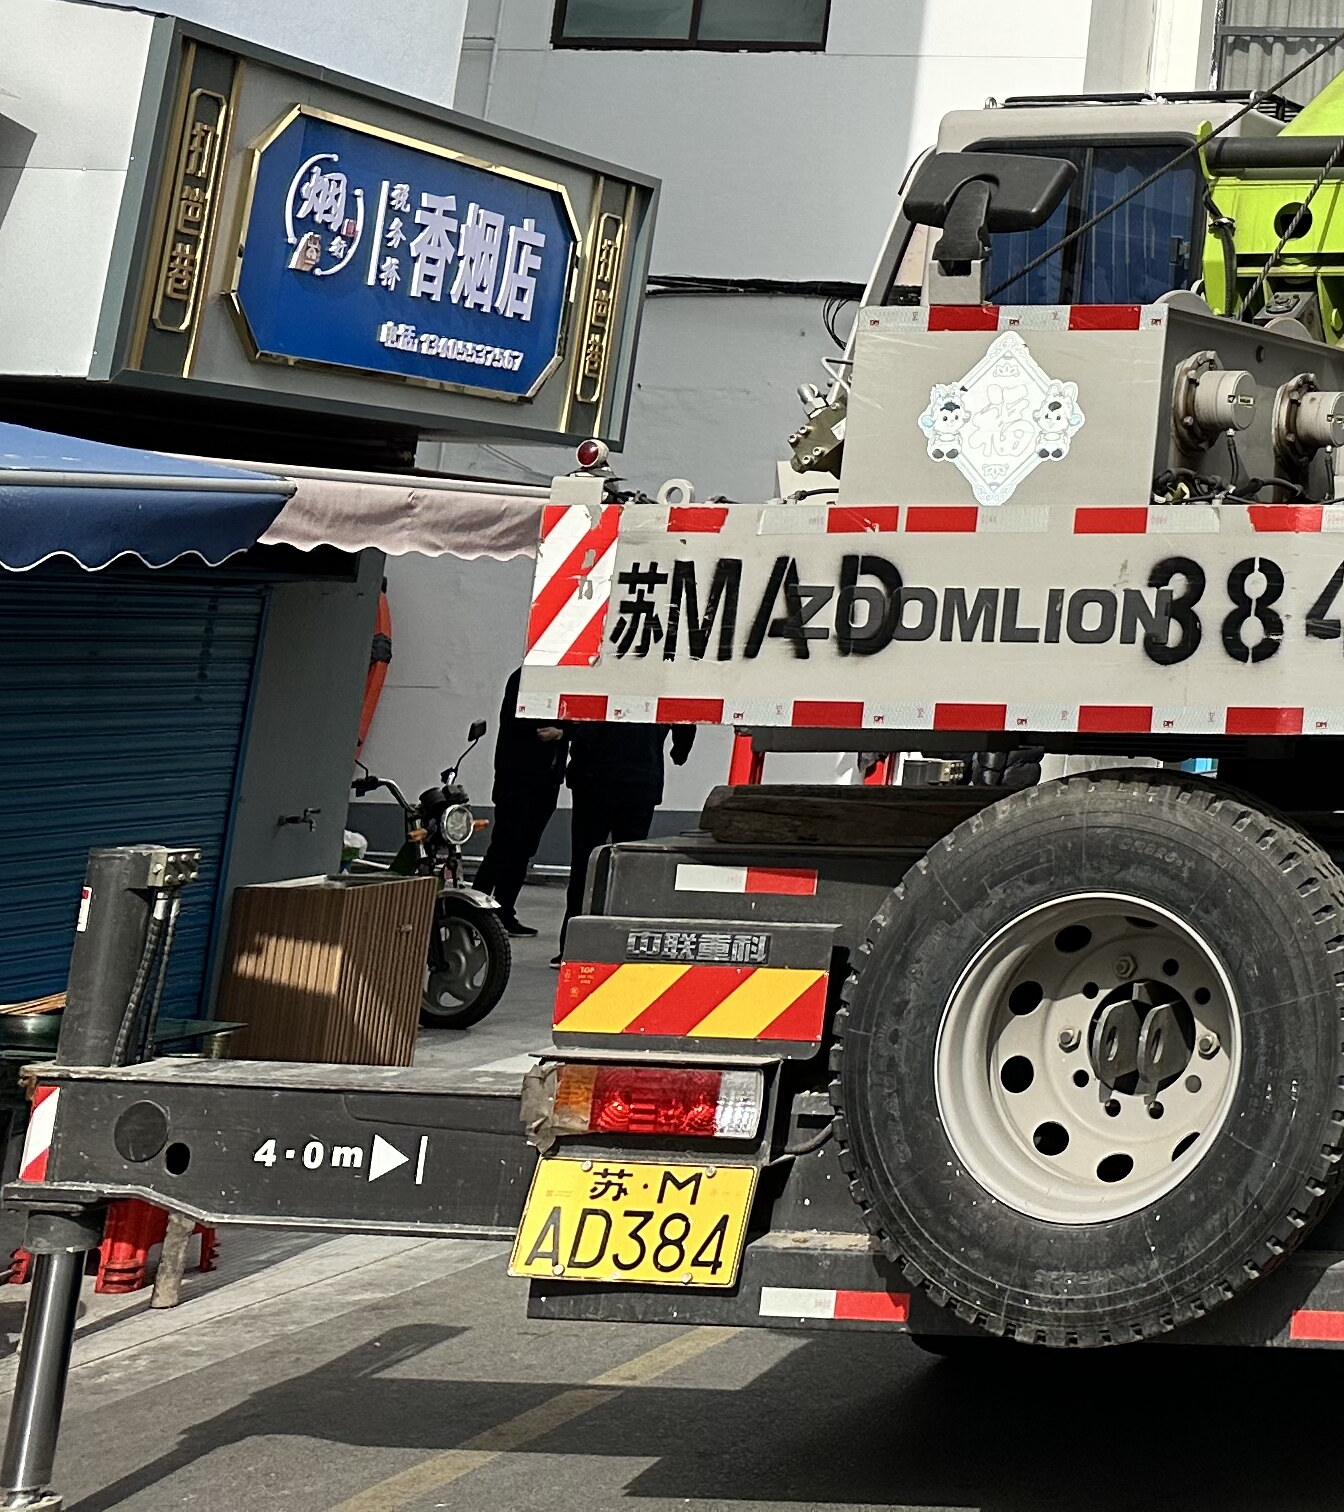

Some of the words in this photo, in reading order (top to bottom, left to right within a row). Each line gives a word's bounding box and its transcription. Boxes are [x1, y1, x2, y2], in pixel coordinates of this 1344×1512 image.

[409, 192, 546, 321] 香烟店
[784, 584, 1174, 644] ZOOMLION
[625, 930, 768, 964] 中联重科
[525, 1206, 729, 1276] AD384
